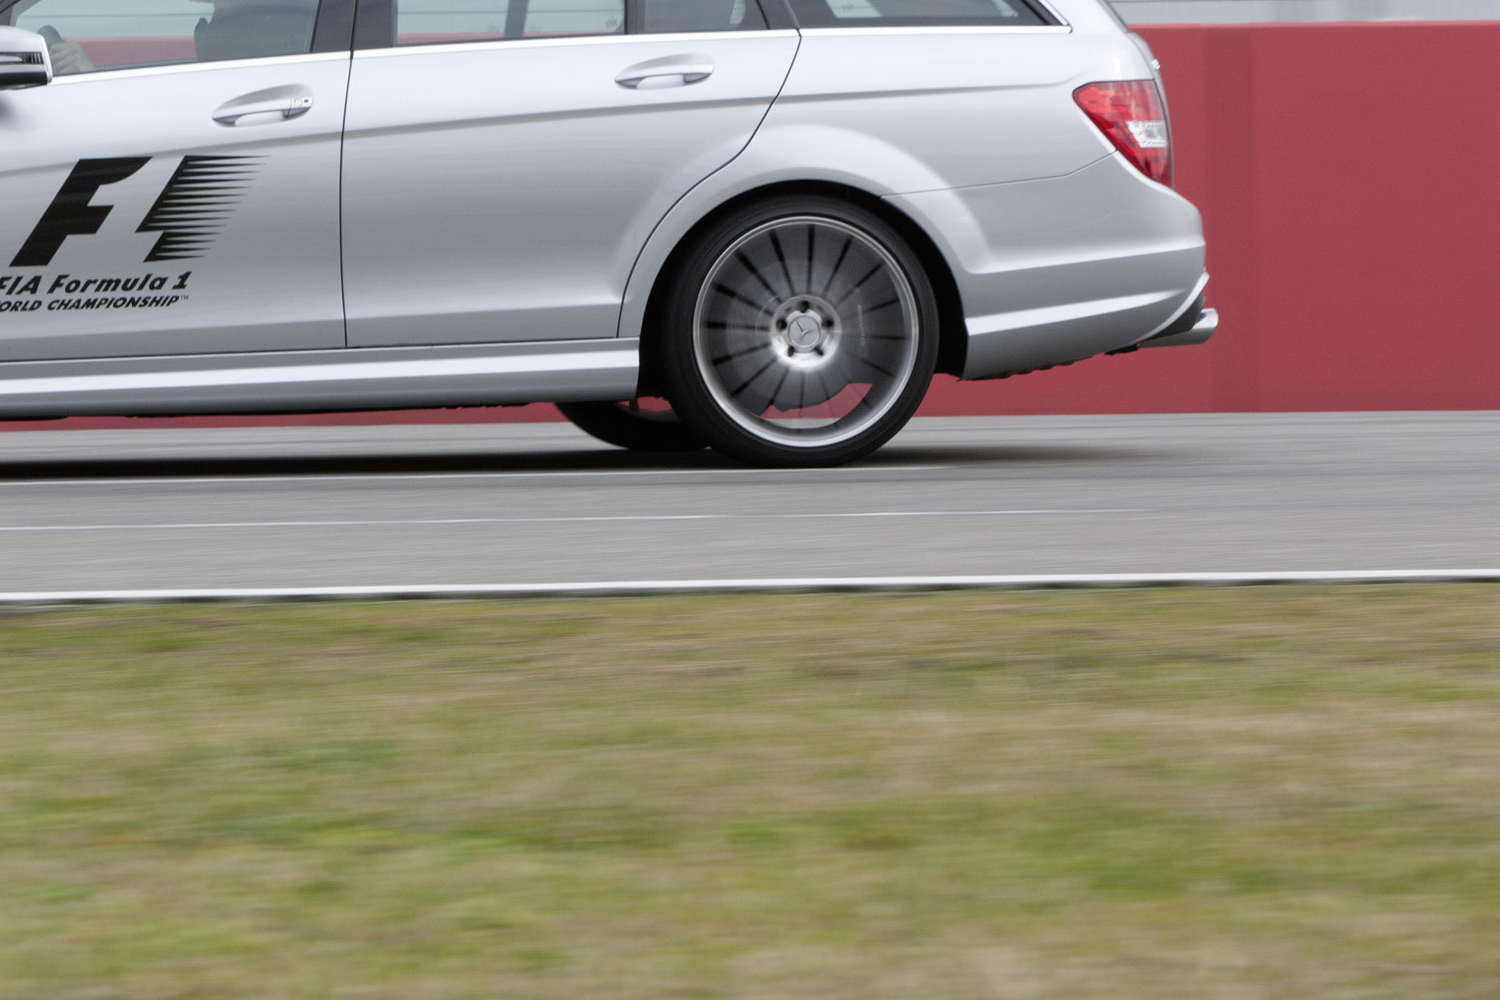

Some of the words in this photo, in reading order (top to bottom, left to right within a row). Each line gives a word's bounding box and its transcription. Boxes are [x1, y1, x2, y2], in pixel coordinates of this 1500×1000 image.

[8, 155, 267, 268] F1
[47, 273, 169, 295] Formula
[171, 271, 192, 291] 1
